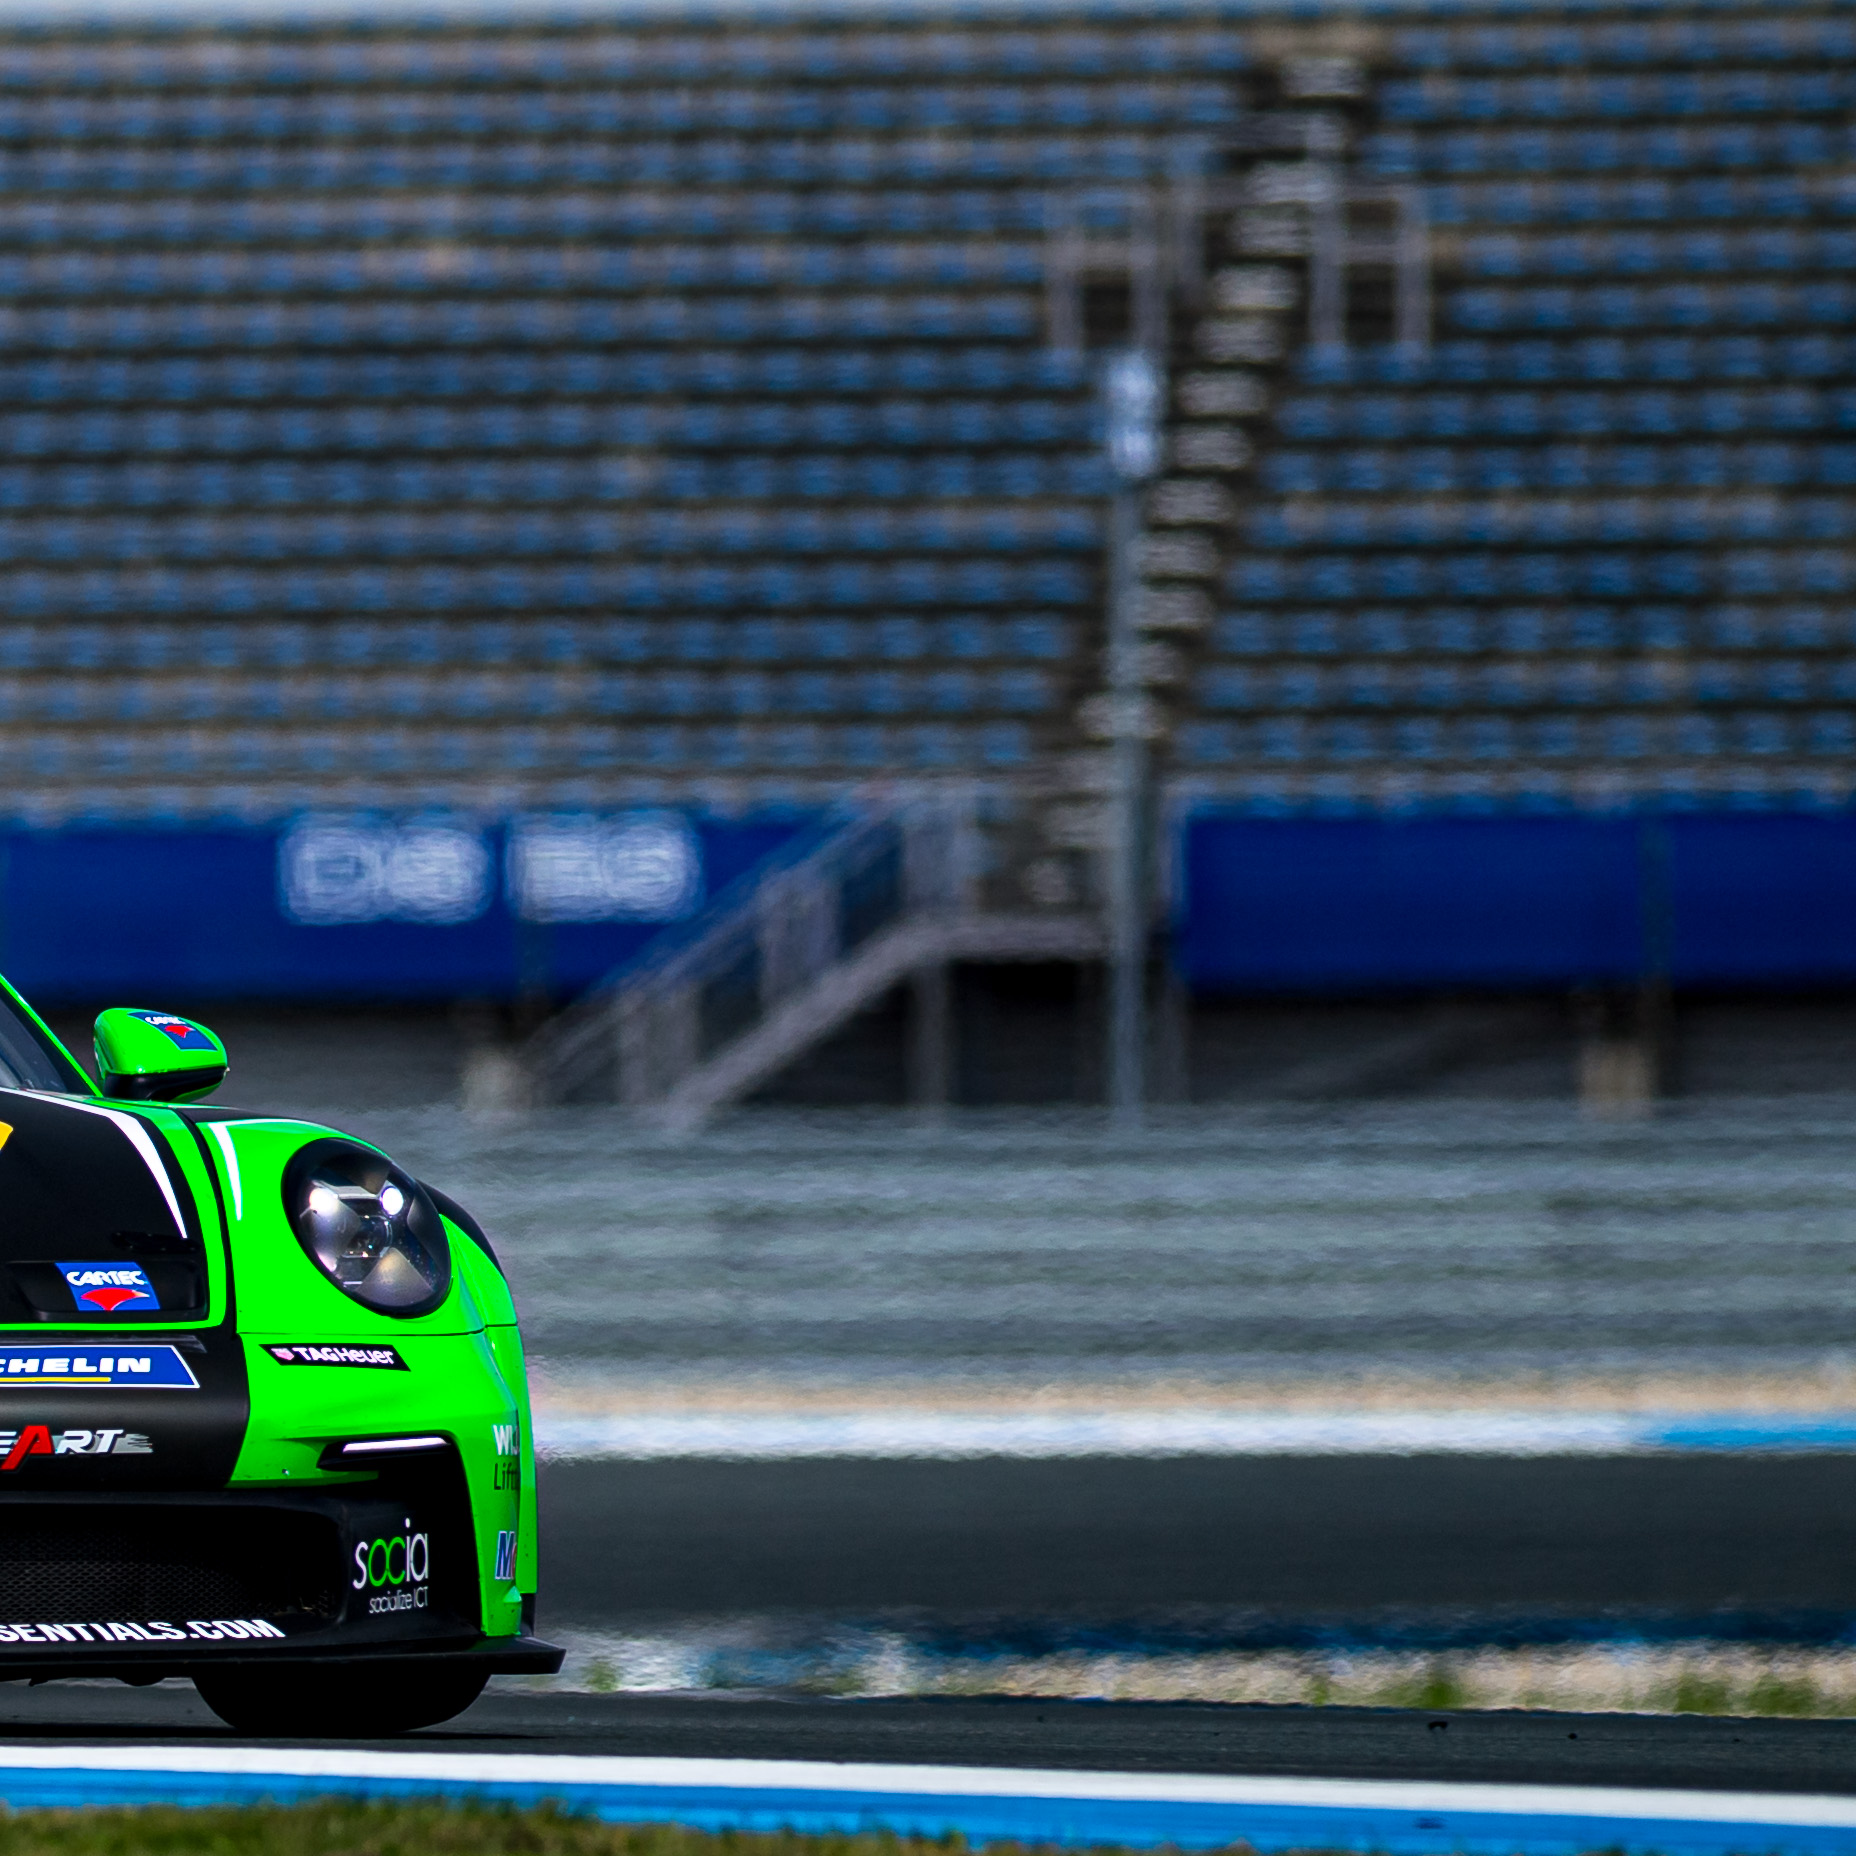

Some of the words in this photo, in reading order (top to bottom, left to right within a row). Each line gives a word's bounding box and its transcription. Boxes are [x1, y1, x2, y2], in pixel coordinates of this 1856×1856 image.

[66, 1270, 146, 1286] CARTEC
[352, 1517, 428, 1589] socia
[368, 1590, 412, 1614] socialize
[413, 1586, 429, 1608] ICT
